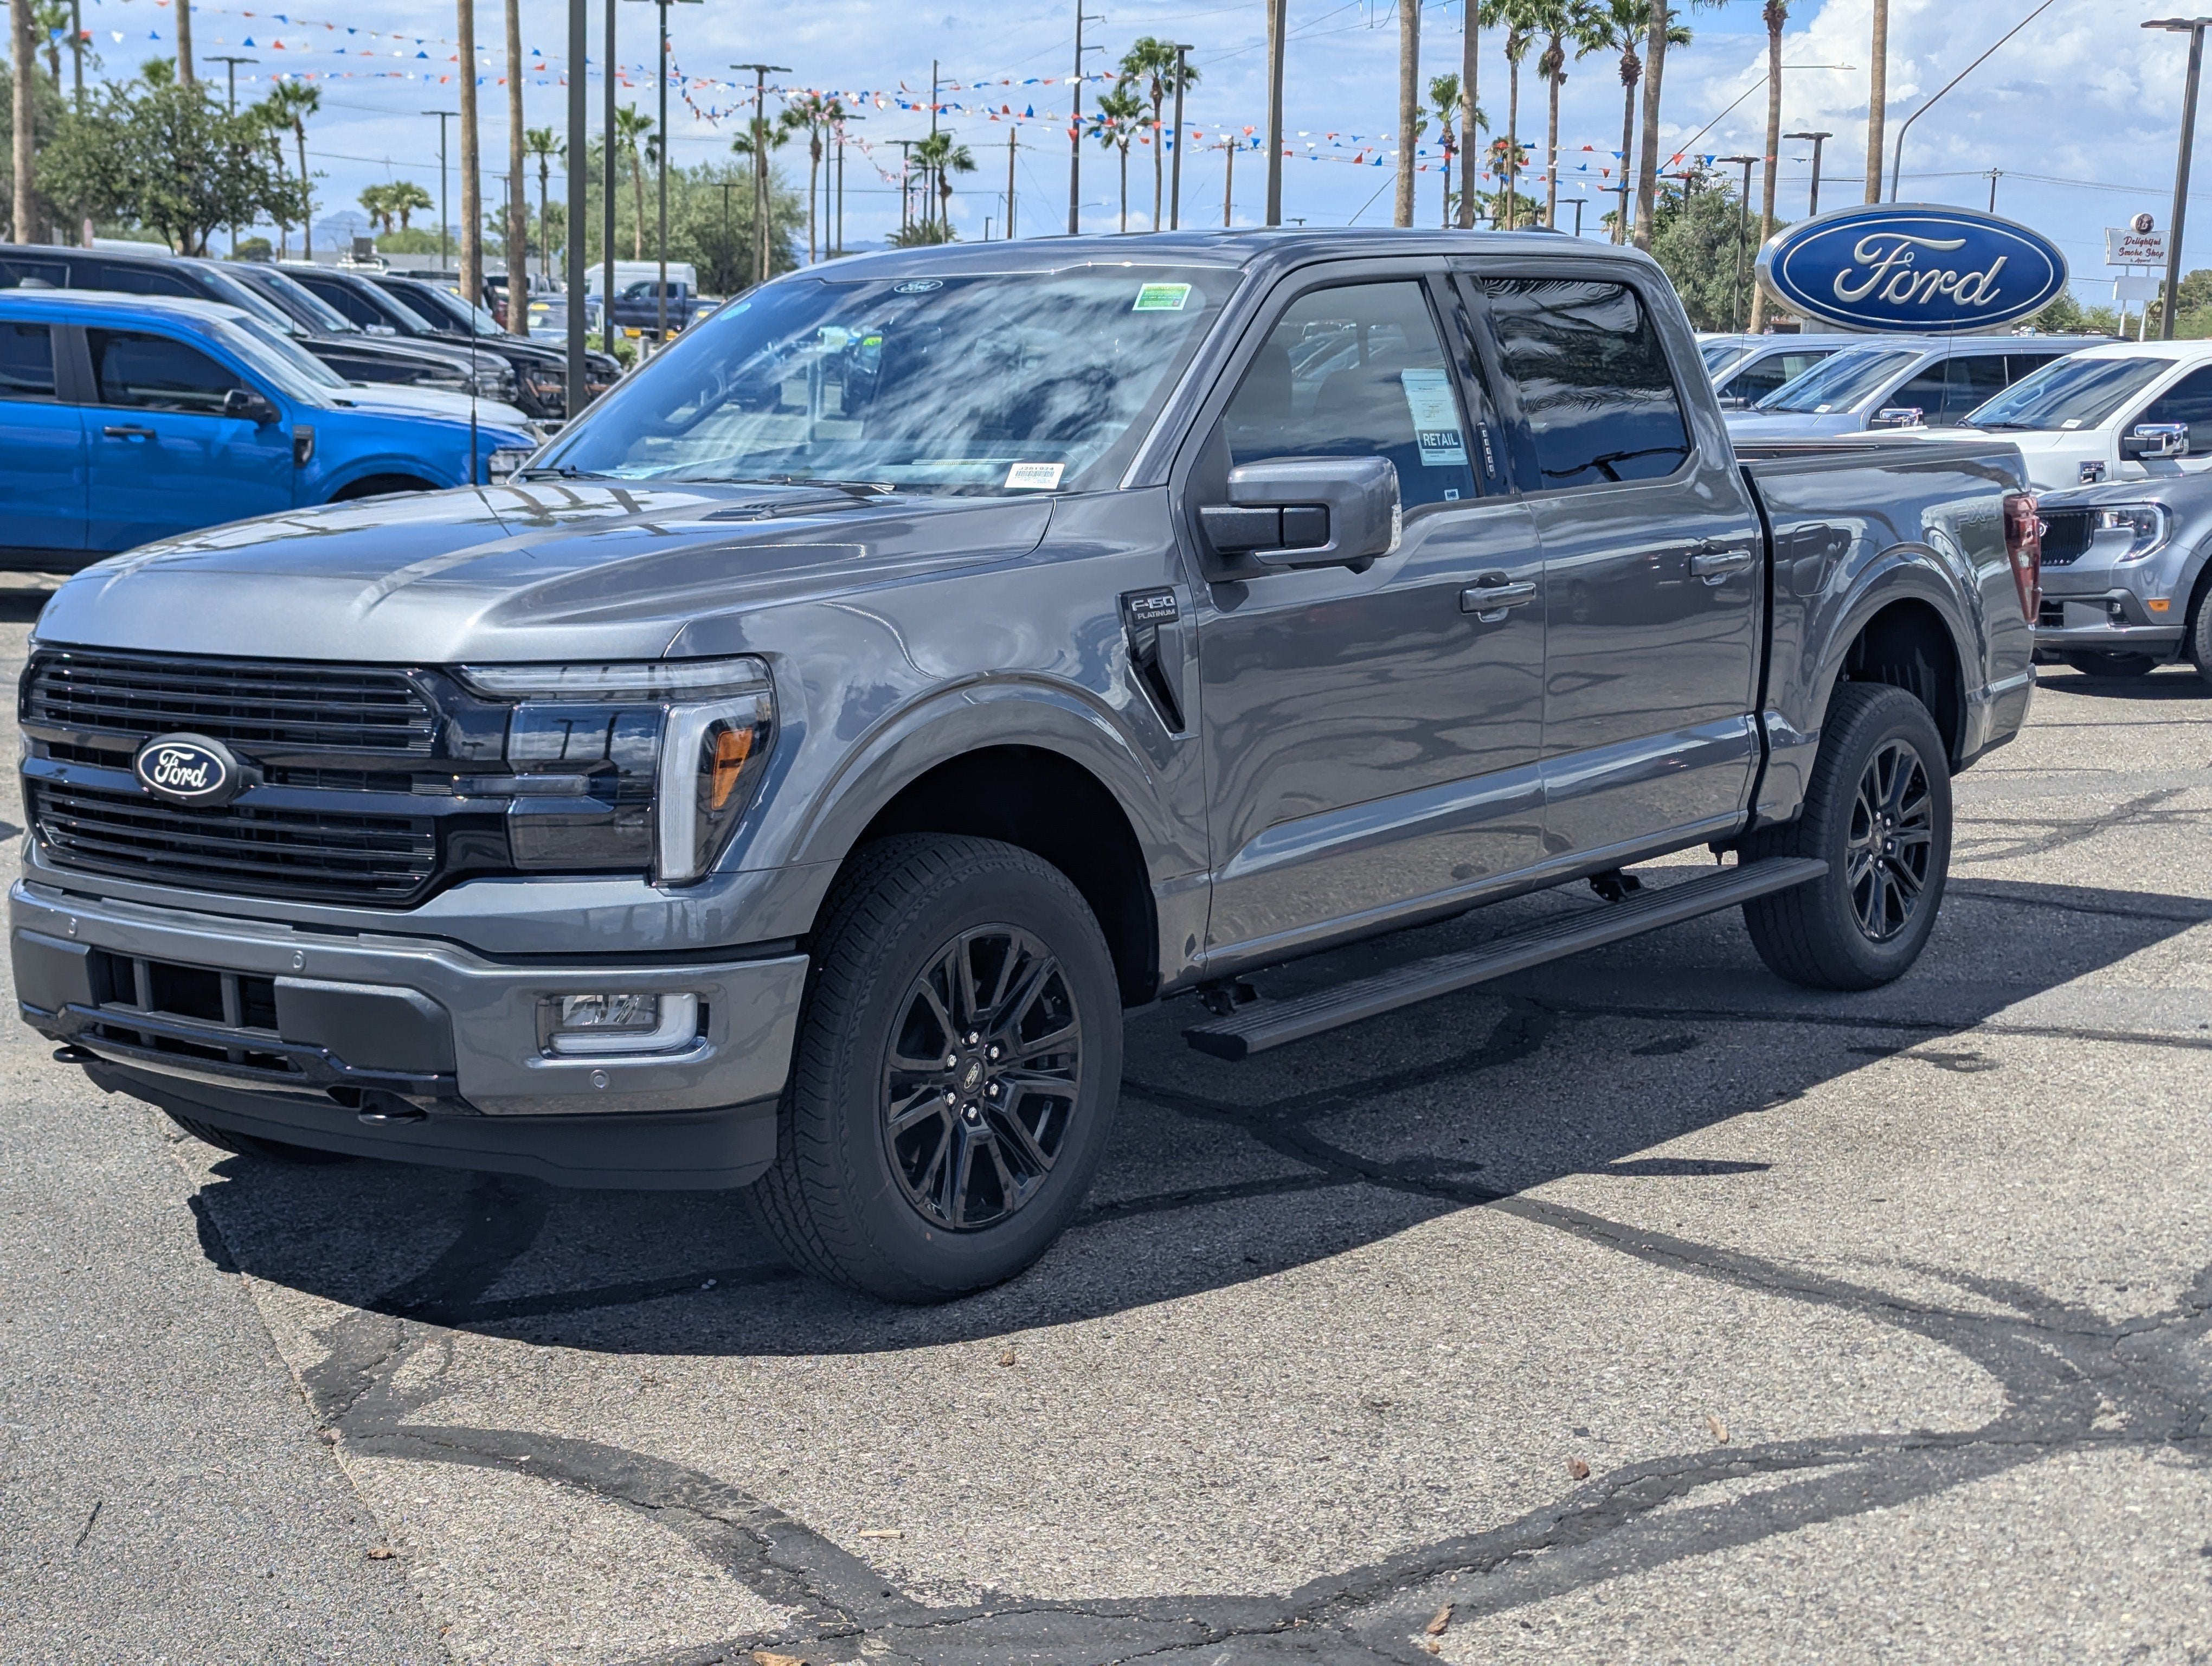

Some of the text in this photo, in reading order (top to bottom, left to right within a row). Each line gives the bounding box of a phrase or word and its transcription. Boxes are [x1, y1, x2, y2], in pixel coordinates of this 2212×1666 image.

[2123, 236, 2162, 248] Delightful
[2118, 247, 2164, 259] Smoke Shop
[1834, 233, 2008, 306] Ford
[1423, 433, 1458, 446] RETAIL
[1954, 502, 1998, 534] FX4
[1131, 595, 1176, 611] F-150
[1136, 608, 1175, 620] PLATINUM
[155, 749, 208, 787] Ford
